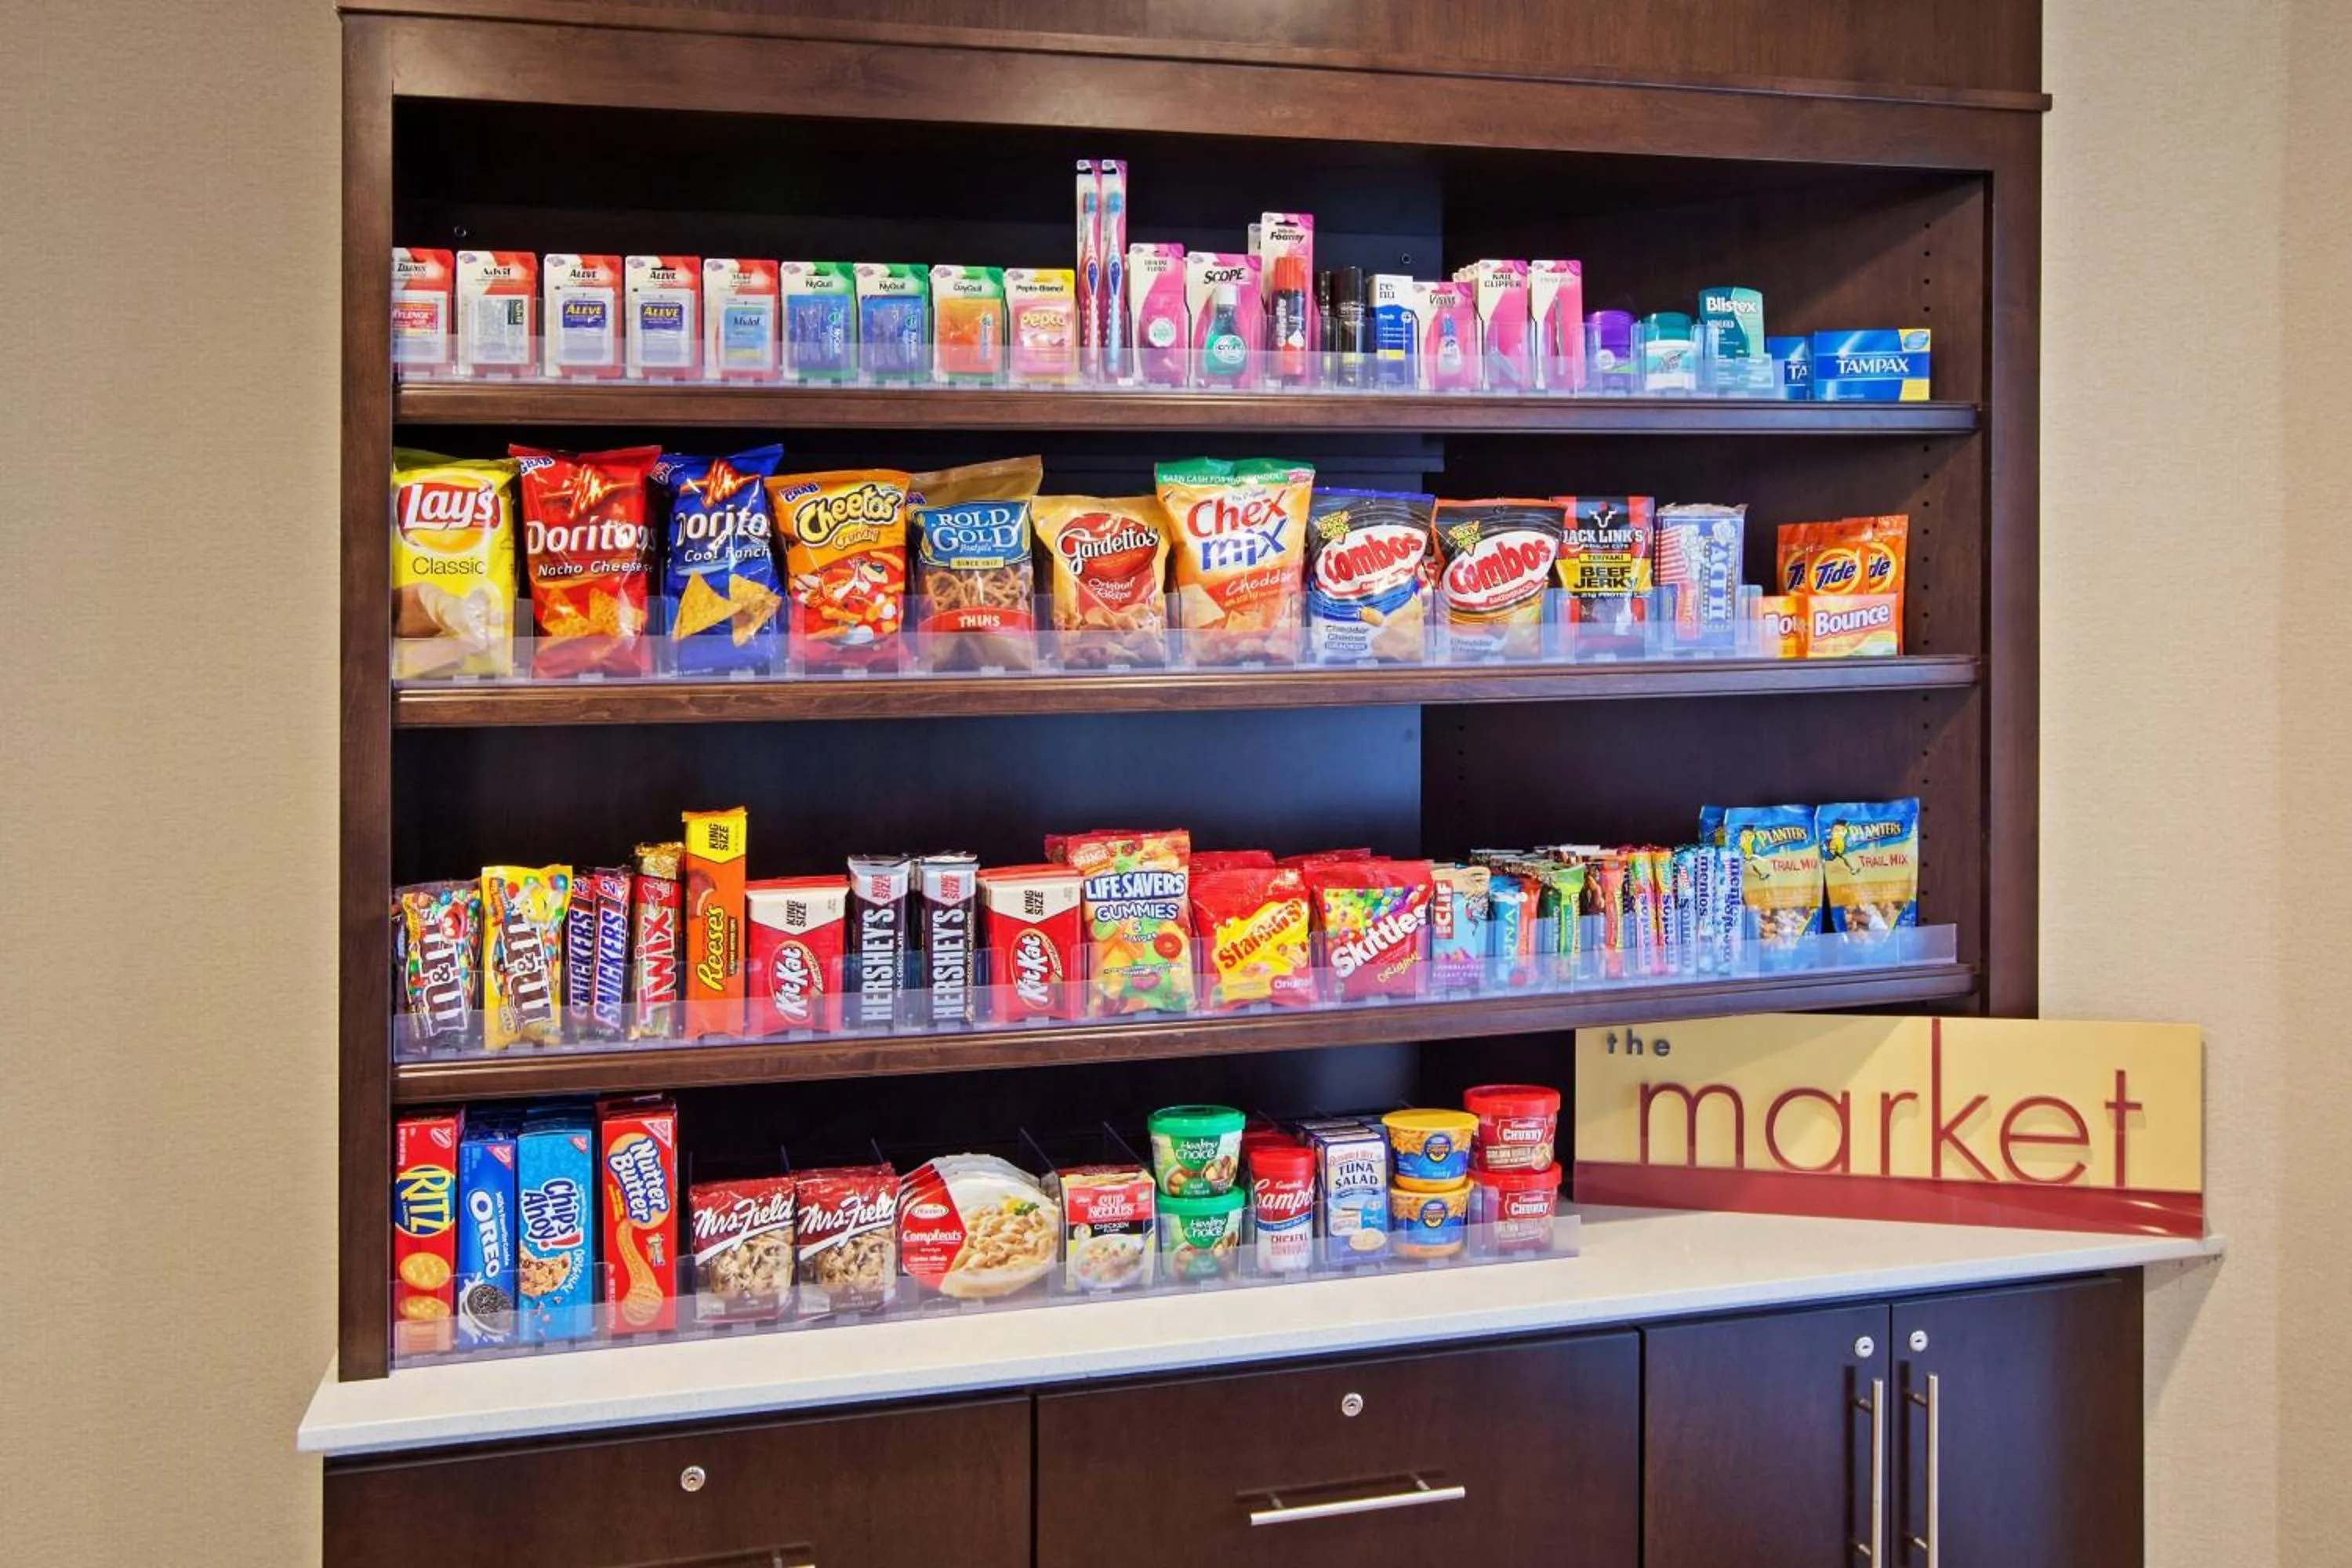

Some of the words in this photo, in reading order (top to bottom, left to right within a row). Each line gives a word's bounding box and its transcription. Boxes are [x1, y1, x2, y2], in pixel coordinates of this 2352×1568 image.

[1269, 231, 1305, 244] Foamy
[805, 280, 833, 290] NyQuil
[879, 282, 906, 292] NyQuil
[1015, 285, 1064, 293] Pepto-Bismol
[1203, 268, 1244, 285] SCOPE
[1706, 296, 1757, 314] Blistex
[1837, 358, 1910, 373] TAMPAX
[403, 481, 496, 531] Lay's
[797, 484, 901, 543] Cheetos
[938, 509, 1011, 528] ROLD
[1186, 489, 1287, 537] Chex
[526, 515, 657, 555] Doritos
[932, 526, 1018, 551] GOLD
[1201, 518, 1287, 571] mix
[1563, 529, 1596, 543] JACK
[1599, 529, 1643, 543] LINK'S
[684, 549, 718, 563] Cool
[726, 545, 770, 560] Ranch
[1056, 527, 1160, 574] Gardetto's
[1324, 532, 1423, 584] Combos
[412, 557, 486, 575] Classic
[538, 561, 583, 576] Nacho
[1449, 539, 1552, 594] Combos
[1581, 566, 1632, 577] BEEF
[1815, 561, 1858, 590] Tide
[1573, 577, 1639, 589] JERKY
[958, 615, 1000, 627] THINS
[1814, 603, 1890, 637] Bounce
[708, 823, 719, 849] KING
[719, 825, 729, 851] SIZE
[1761, 827, 1807, 845] PLANTERS
[1848, 823, 1901, 841] PLANTERS
[1770, 858, 1798, 872] TRAIL
[1859, 855, 1888, 867] TRAIL
[1890, 854, 1908, 866] MIX
[872, 874, 881, 898] KING
[881, 875, 891, 900] SIZE
[951, 875, 961, 900] SIZE
[1084, 874, 1122, 900] LIFE
[1121, 872, 1186, 898] SAVERS
[1699, 855, 1710, 916] mentos
[786, 900, 796, 926] KING
[797, 901, 807, 927] SIZE
[1024, 890, 1034, 915] KING
[1034, 891, 1044, 916] SIZE
[1096, 903, 1178, 922] GUMMIES
[695, 904, 725, 992] Reese's
[1330, 904, 1426, 978] Skittles
[570, 909, 593, 1017] SNICKERS
[596, 909, 626, 1027] SNICKERS
[862, 909, 895, 1020] HERSHEY'S
[932, 909, 965, 1020] HERSHEY'S
[1607, 1028, 1671, 1057] the
[1639, 1018, 2143, 1189] market
[1503, 1128, 1544, 1142] CHUNKY
[1175, 1149, 1216, 1160] Choice
[630, 1138, 667, 1212] Nutter
[1334, 1174, 1378, 1189] SALAD
[1339, 1162, 1374, 1176] TUNA
[608, 1153, 649, 1222] Butter
[398, 1170, 451, 1233] RITZ
[543, 1179, 578, 1236] Chips
[1088, 1205, 1134, 1218] NOODLES
[1098, 1194, 1126, 1207] CUP
[1510, 1202, 1549, 1214] CHUNKY
[470, 1190, 500, 1278] OREO
